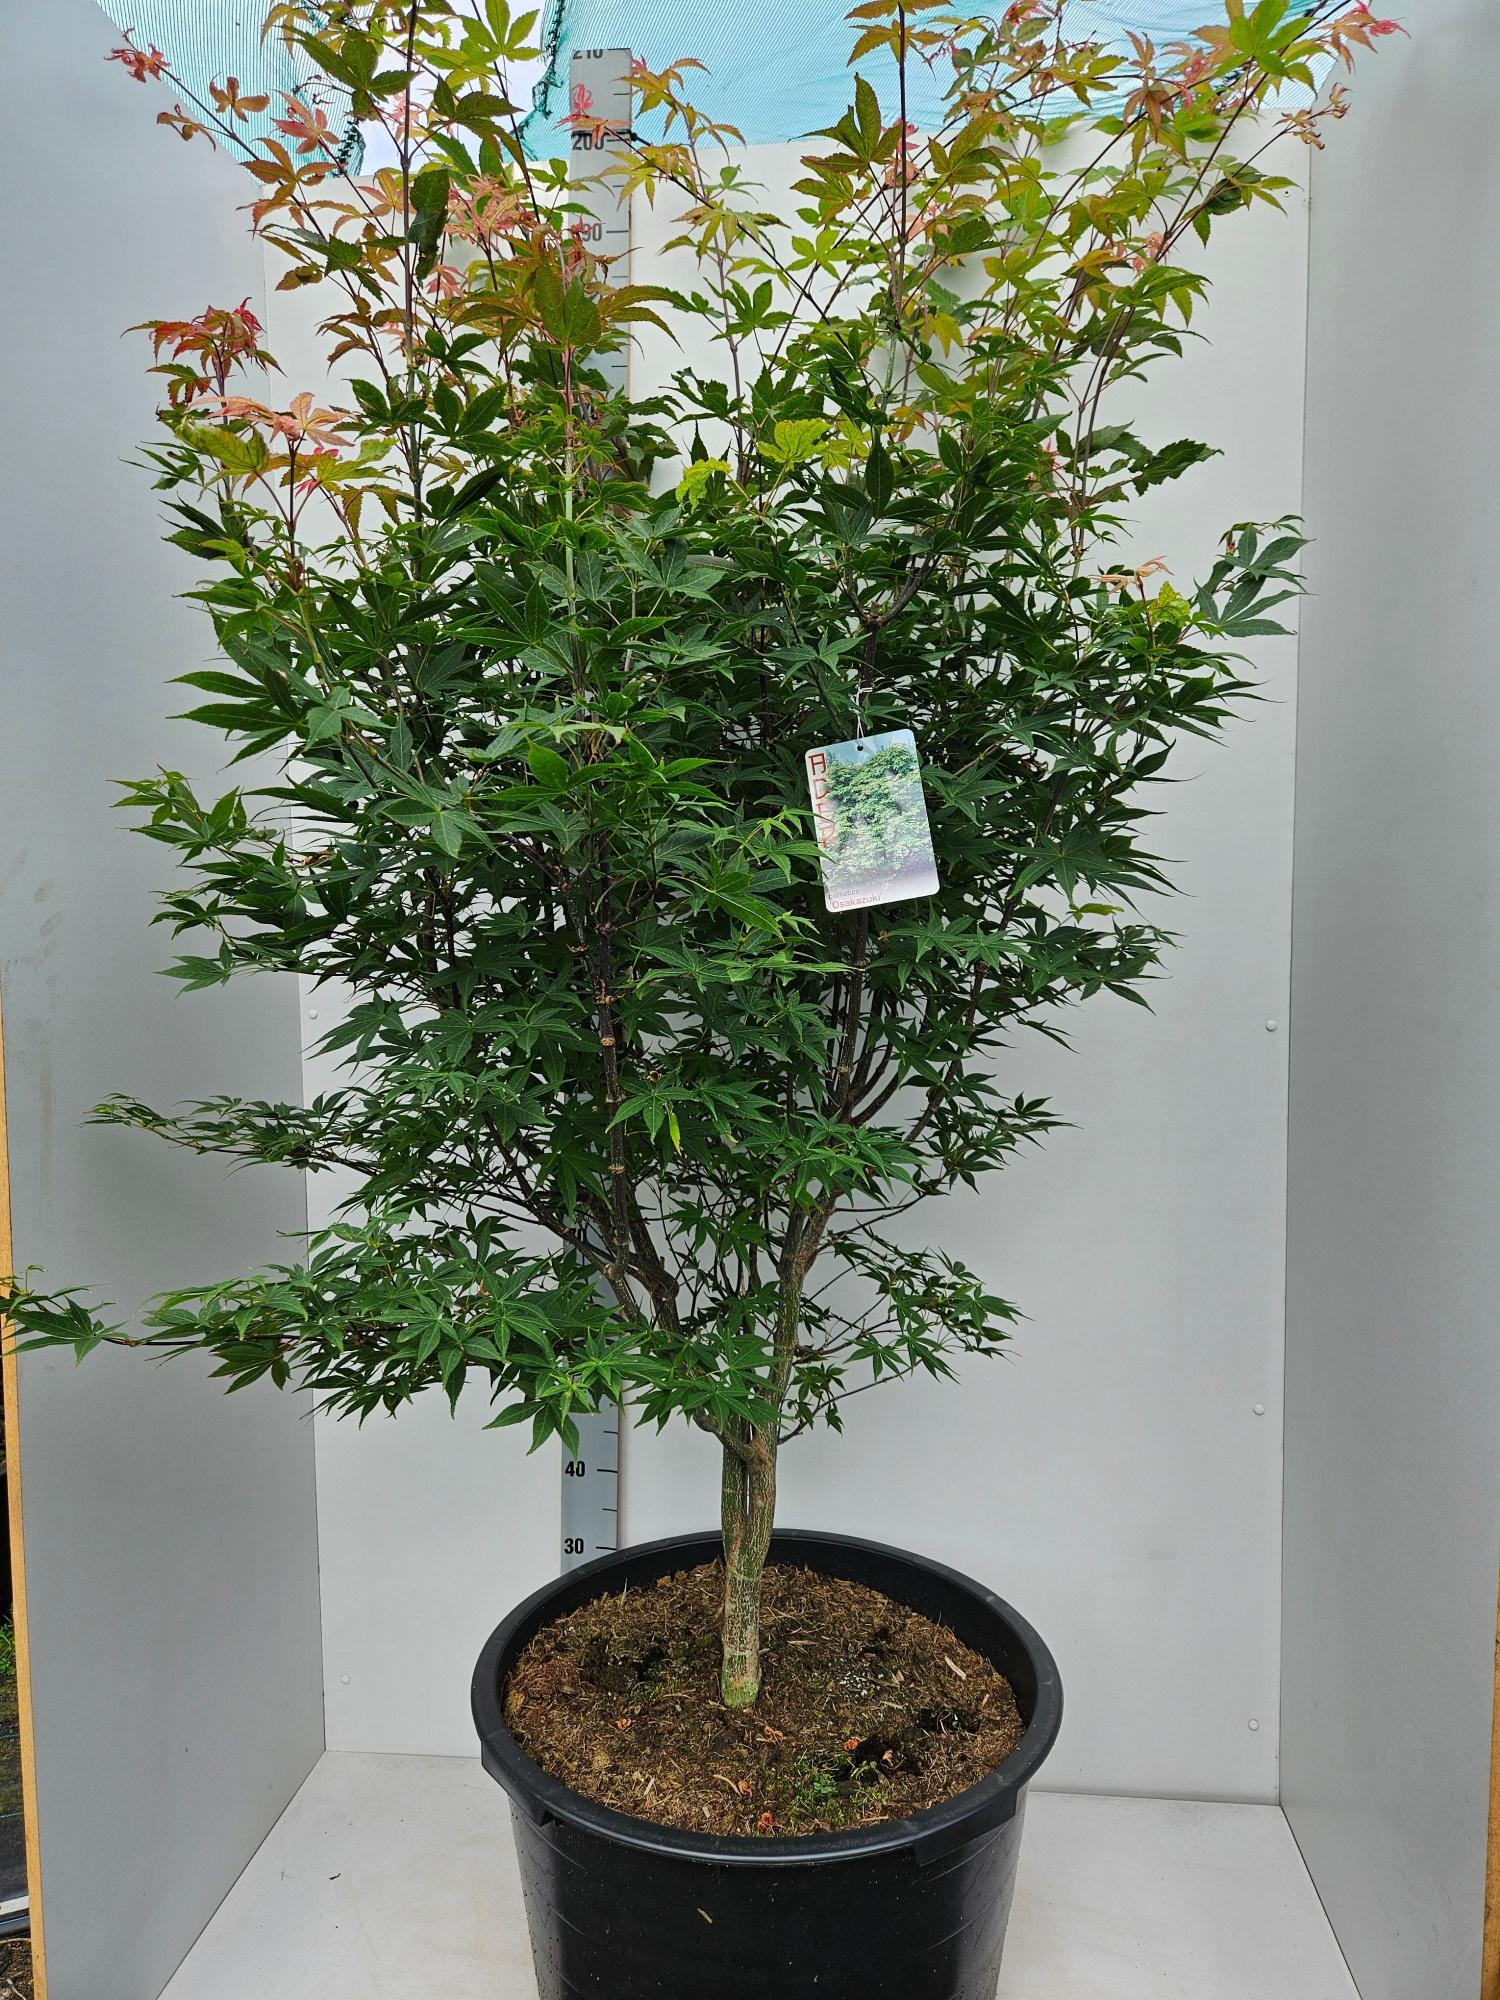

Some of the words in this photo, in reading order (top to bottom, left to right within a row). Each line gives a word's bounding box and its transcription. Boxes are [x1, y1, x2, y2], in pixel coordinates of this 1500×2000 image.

[572, 133, 605, 151] 200
[577, 223, 603, 242] 90
[808, 753, 837, 848] ACER
[565, 1461, 586, 1477] 40
[564, 1538, 585, 1554] 30
